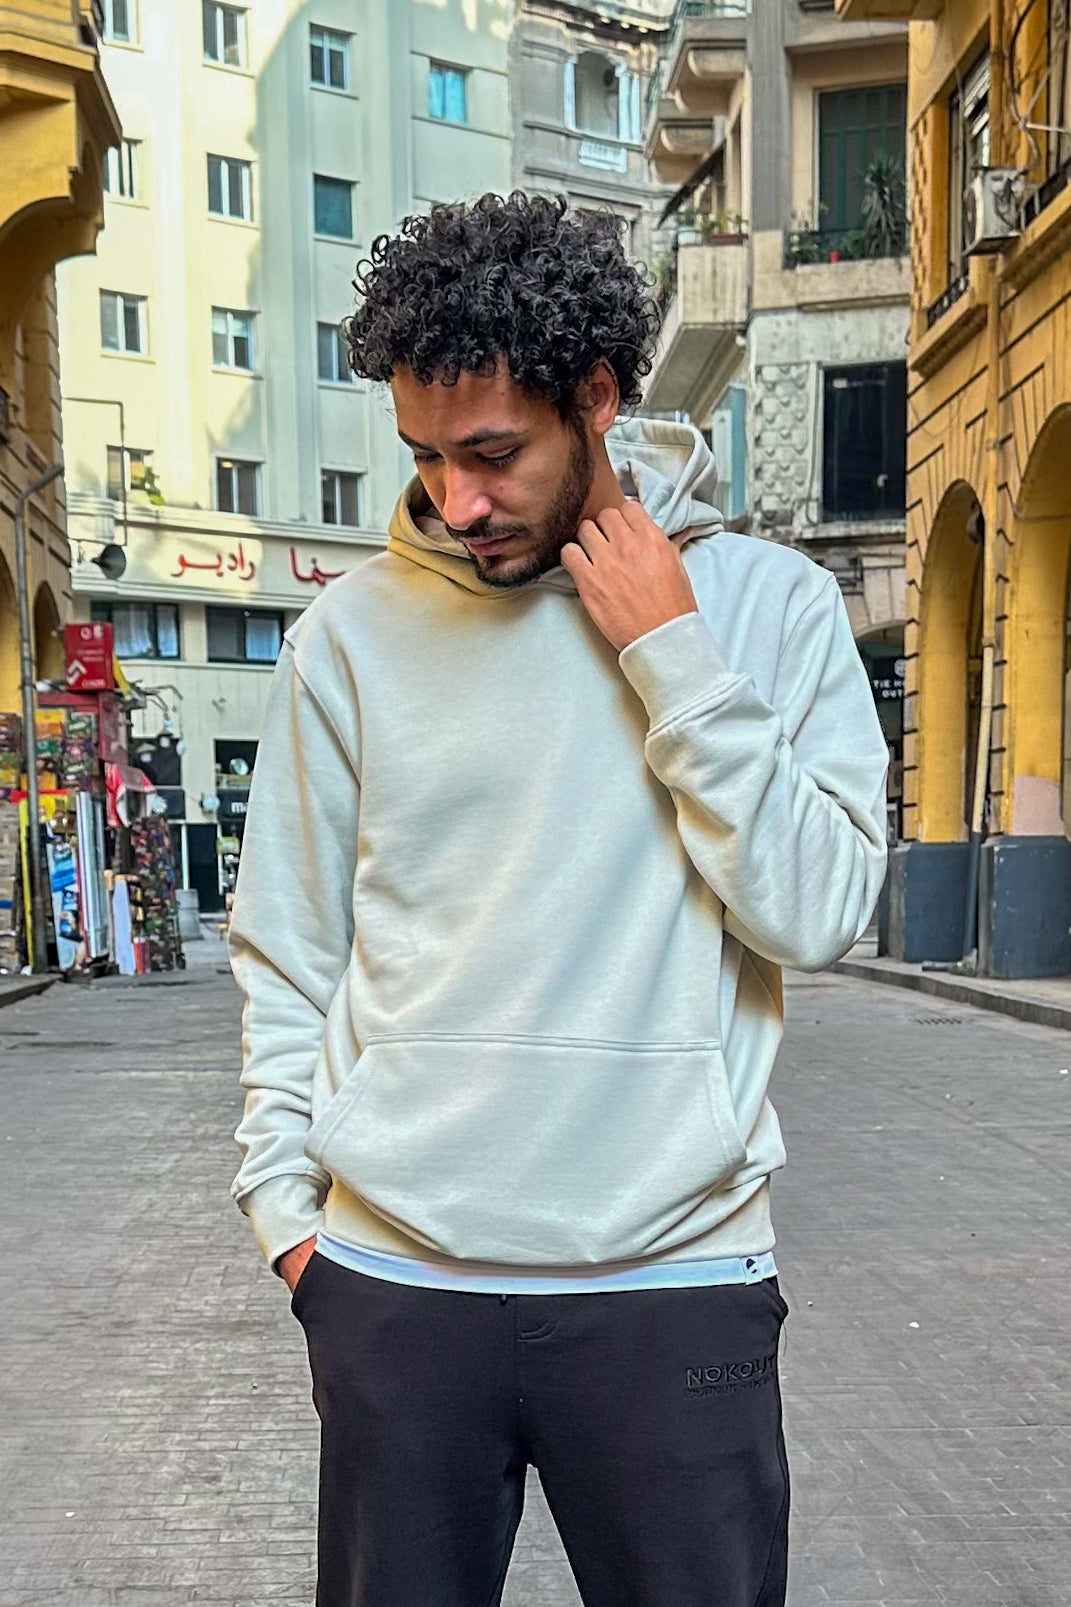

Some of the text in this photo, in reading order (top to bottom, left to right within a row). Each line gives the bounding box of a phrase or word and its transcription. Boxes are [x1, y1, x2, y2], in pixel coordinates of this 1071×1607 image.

[170, 540, 256, 581] راديو
[882, 689, 903, 699] OUT
[686, 1354, 776, 1389] NOKOUT
